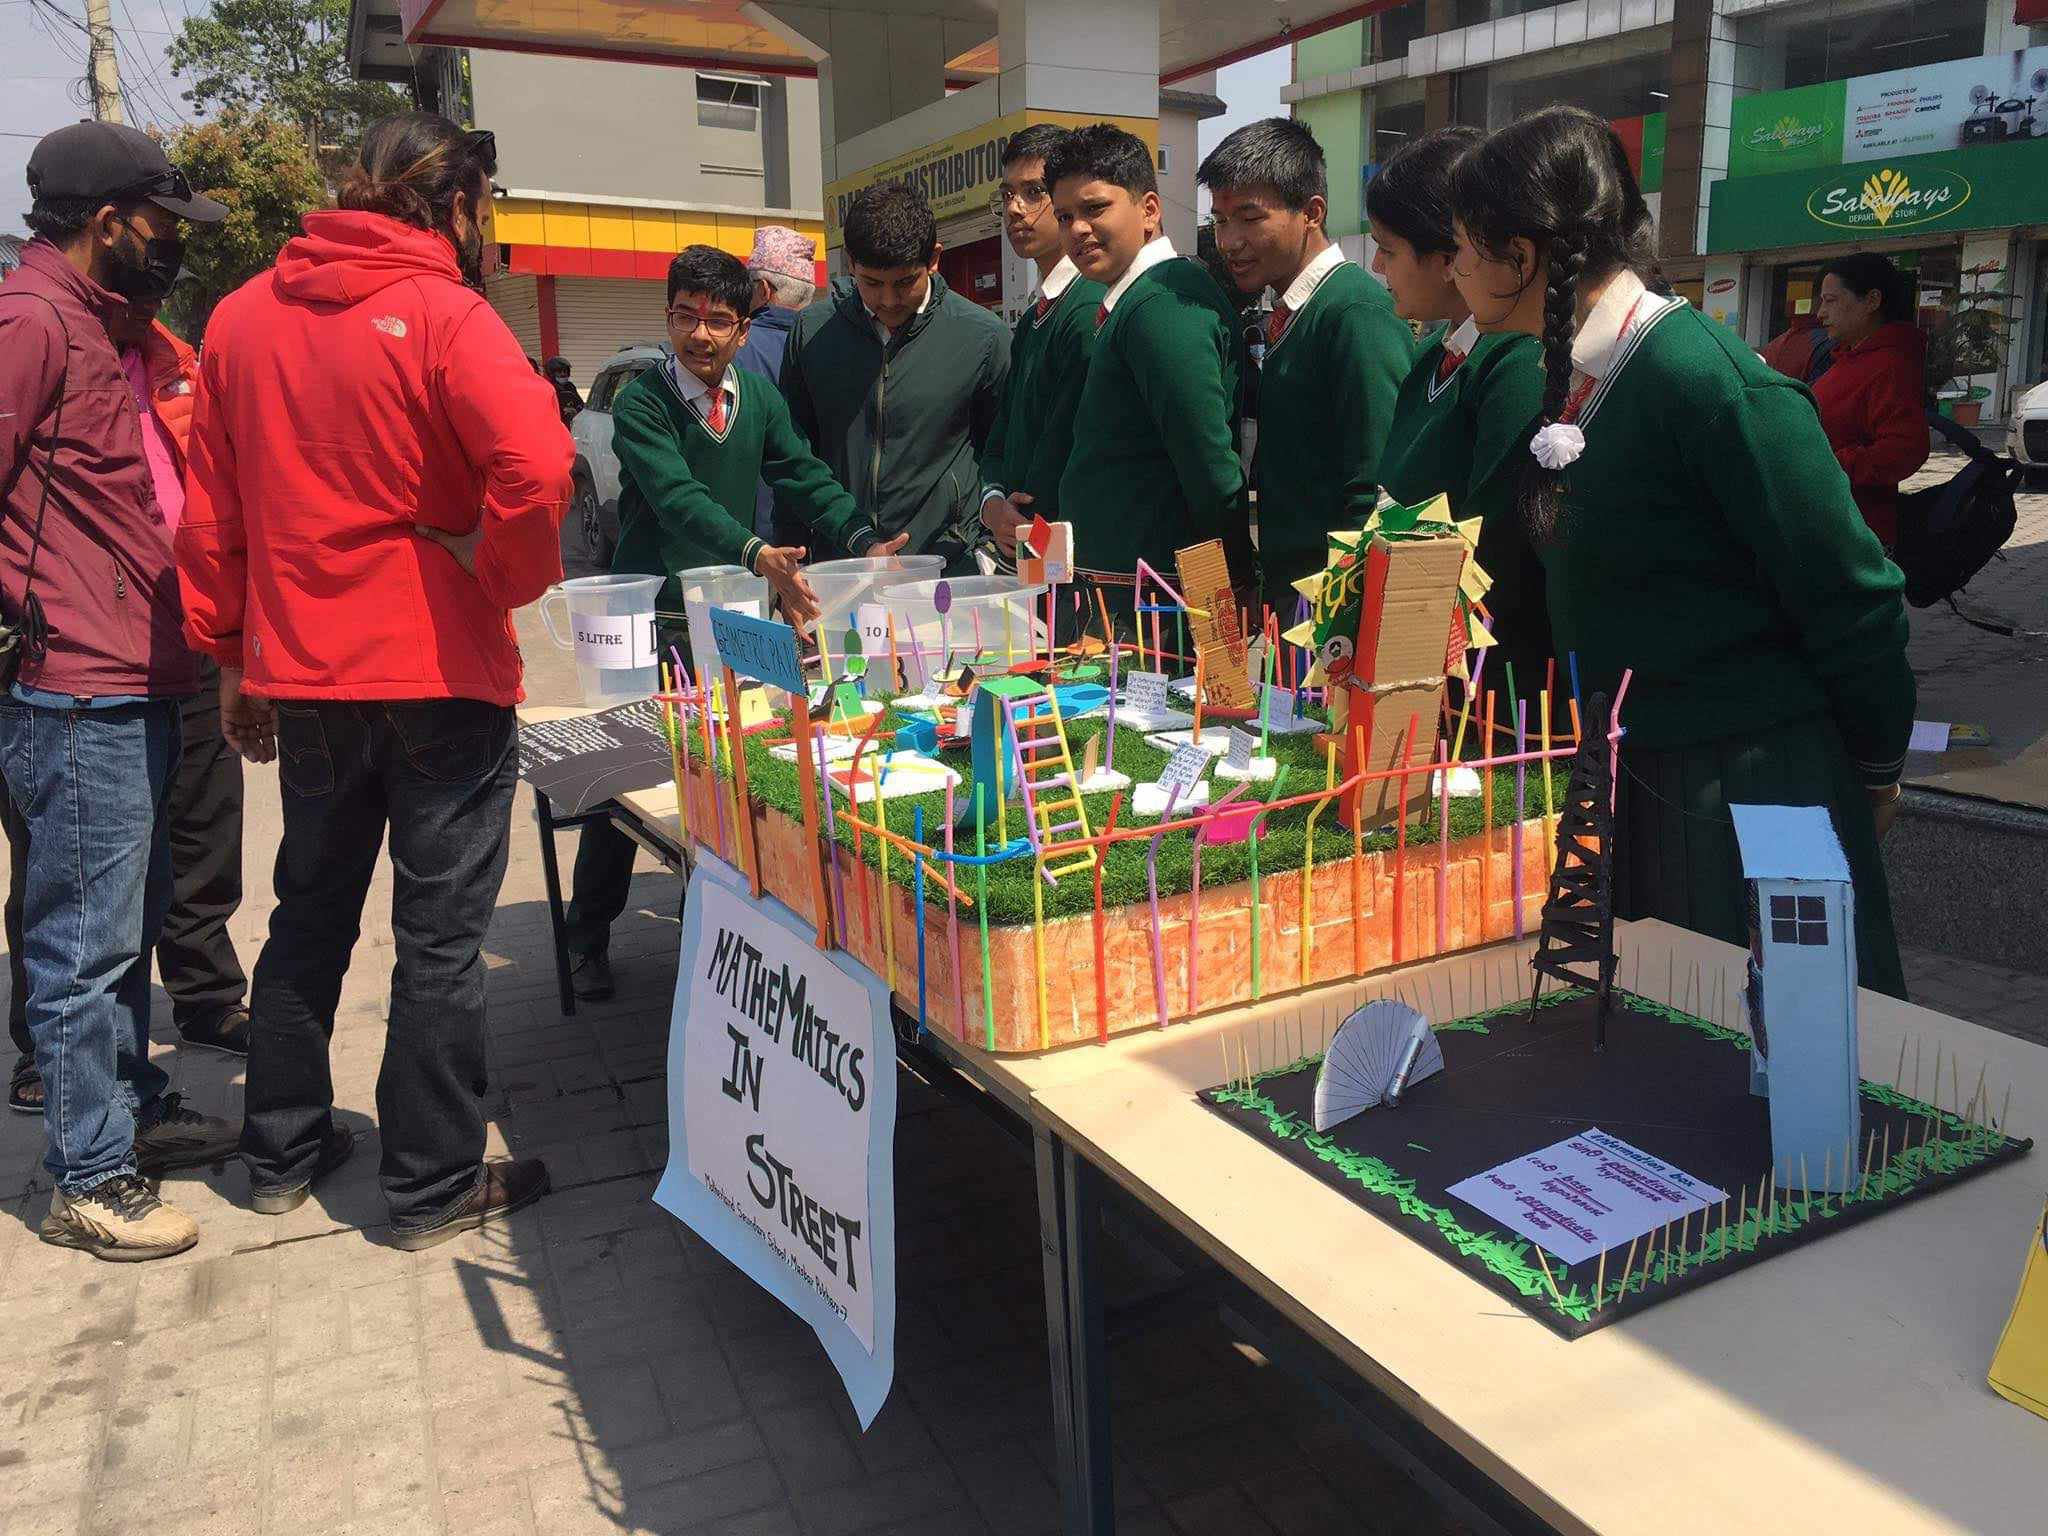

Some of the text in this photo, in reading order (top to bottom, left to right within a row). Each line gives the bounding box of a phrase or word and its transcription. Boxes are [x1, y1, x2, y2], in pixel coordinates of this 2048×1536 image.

[1822, 183, 1952, 215] Saleways
[1895, 207, 1918, 219] STORE
[578, 631, 623, 646] 5 LITRE
[865, 626, 882, 638] 10
[722, 1022, 765, 1113] IN
[1562, 1174, 1593, 1194] base
[1669, 1172, 1696, 1188] box
[745, 1133, 862, 1293] STREET
[1522, 1211, 1552, 1231] base
